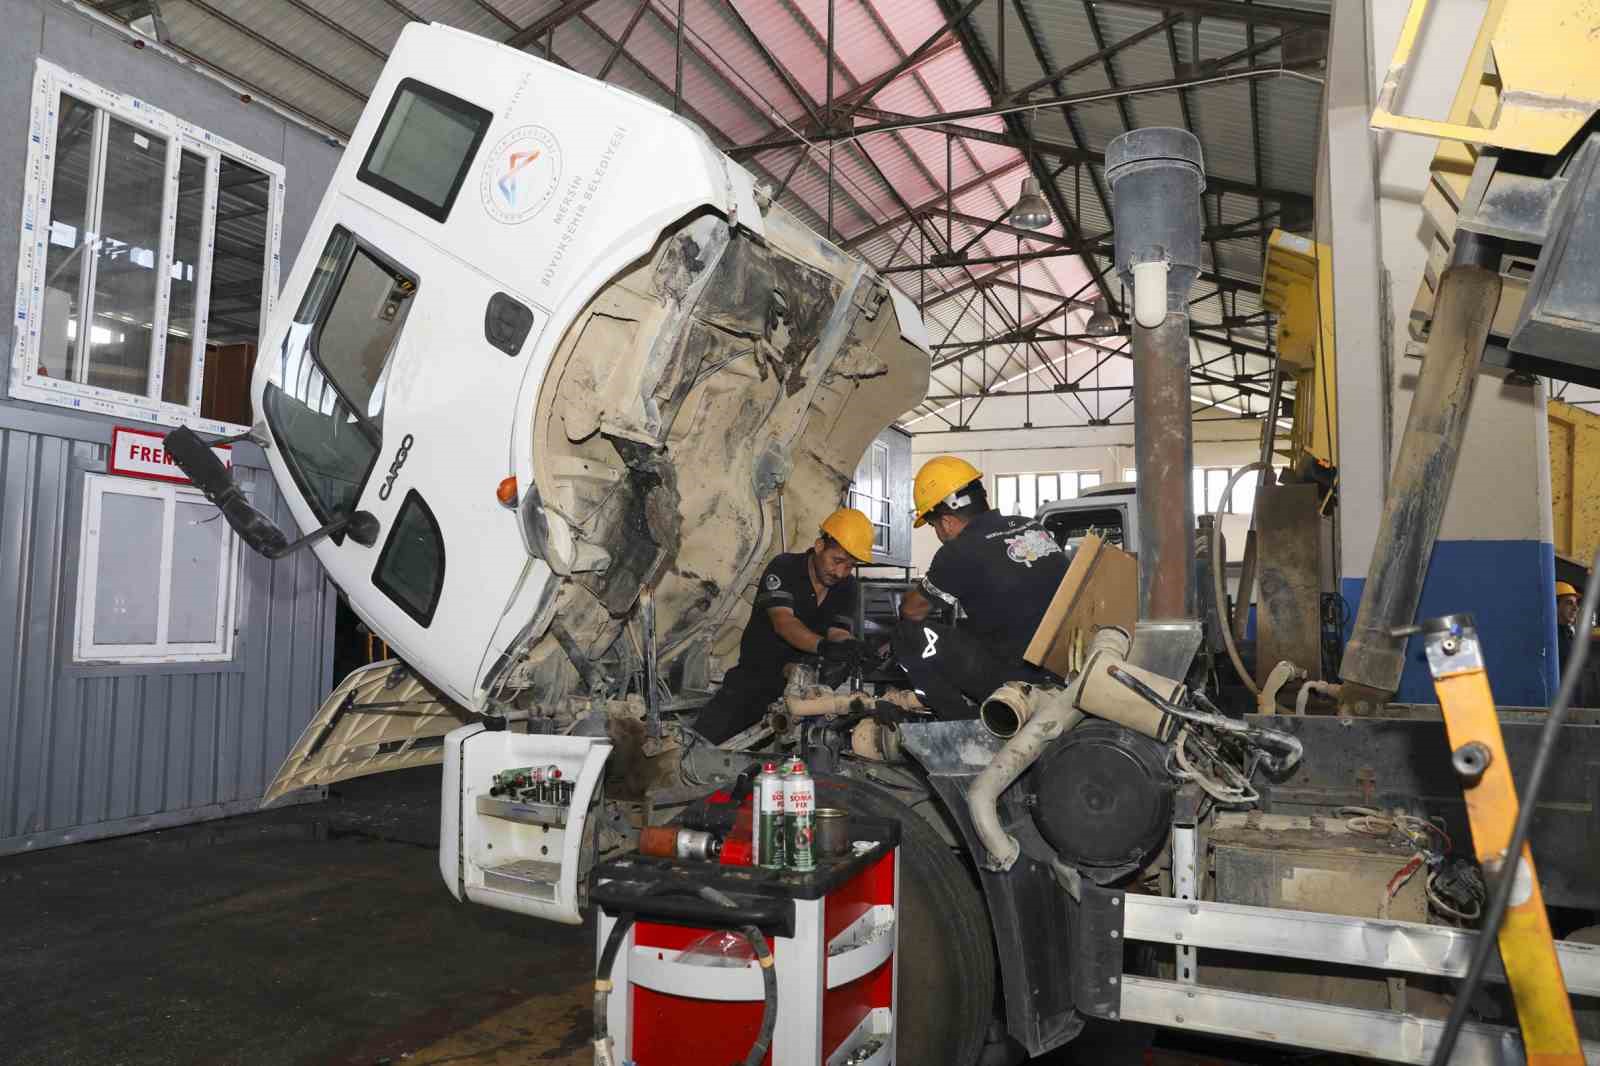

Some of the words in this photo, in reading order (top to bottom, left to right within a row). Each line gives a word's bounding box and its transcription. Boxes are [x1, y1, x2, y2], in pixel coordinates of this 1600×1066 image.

[541, 202, 587, 287] BÜYÜKŞEHİR
[584, 125, 629, 201] BELEDİYESİ
[553, 175, 584, 225] MERSİN
[379, 433, 414, 502] CARGO
